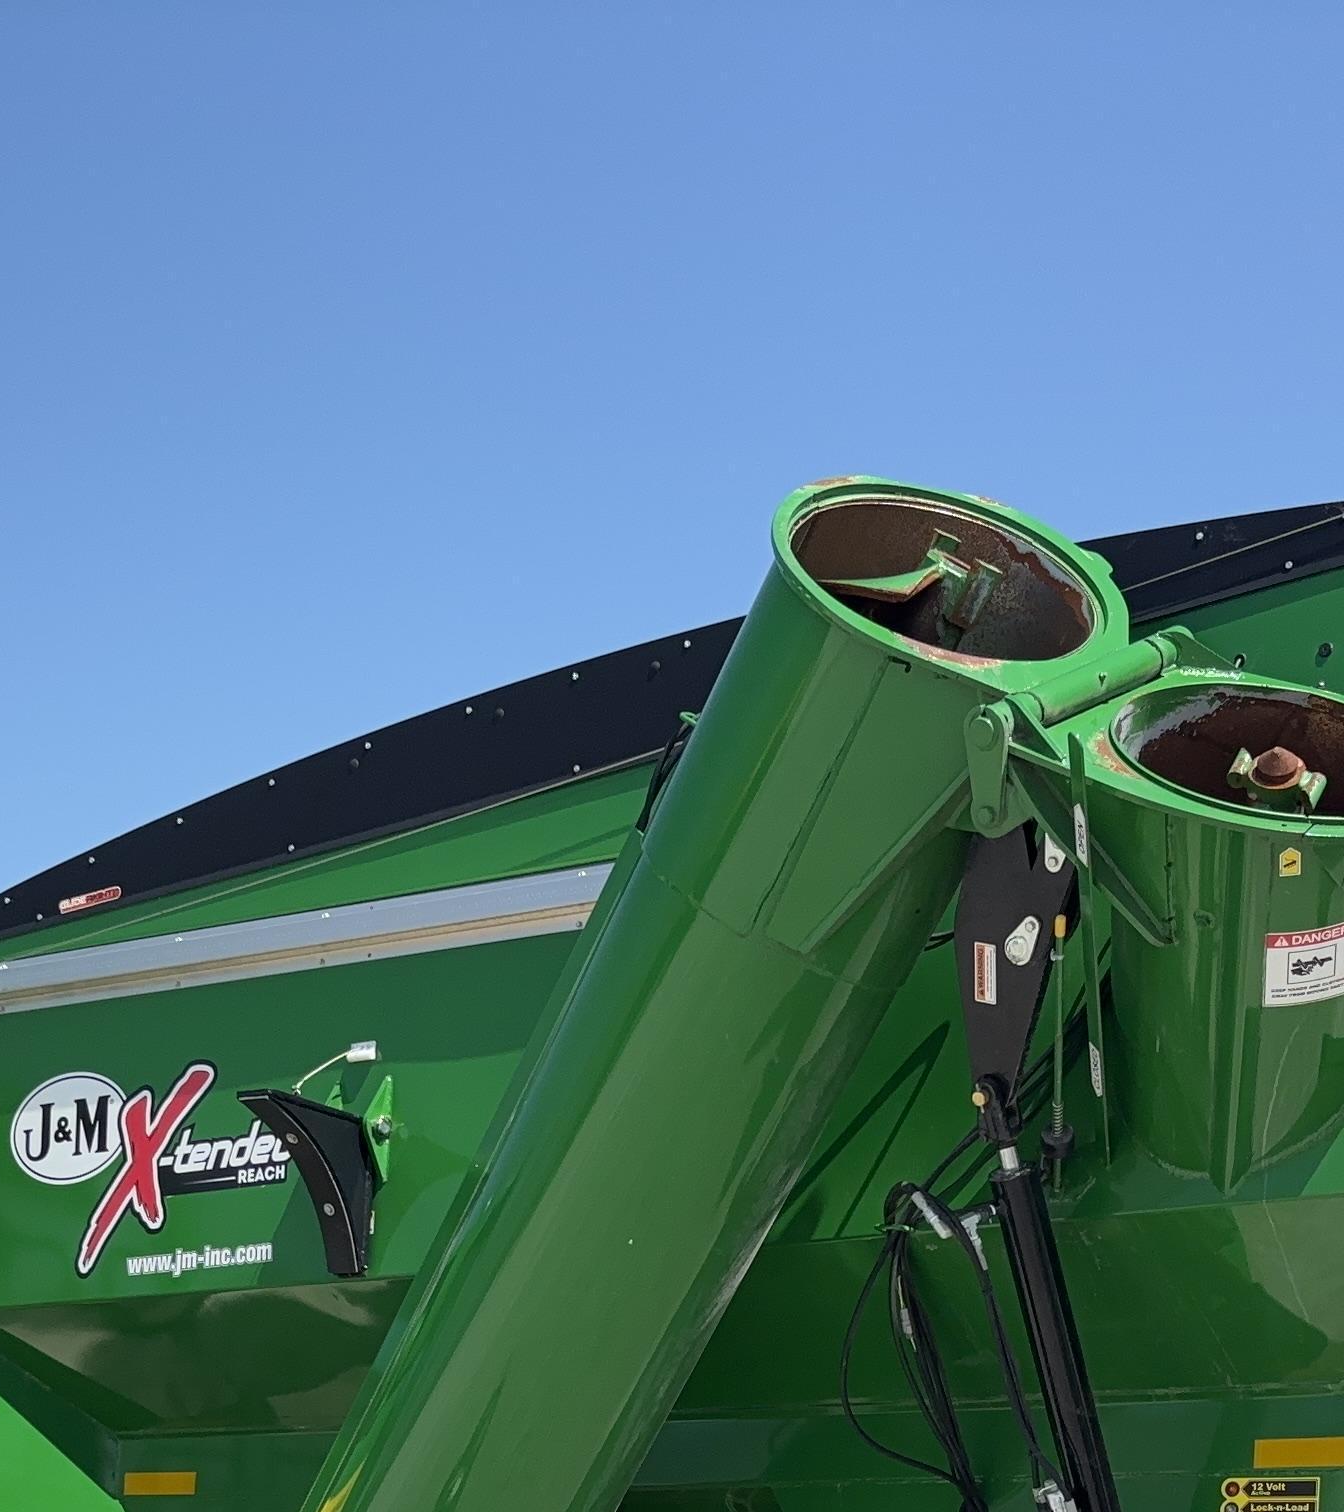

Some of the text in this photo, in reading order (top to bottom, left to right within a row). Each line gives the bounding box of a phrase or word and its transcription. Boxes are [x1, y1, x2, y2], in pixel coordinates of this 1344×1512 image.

[1078, 822, 1086, 854] OPEN
[23, 1095, 112, 1162] J&M
[237, 1164, 286, 1185] REACH
[127, 1242, 274, 1278] www.jm-inc.com
[1251, 1482, 1286, 1491] 12 Volt
[1250, 1503, 1310, 1512] Lock-n-Load
